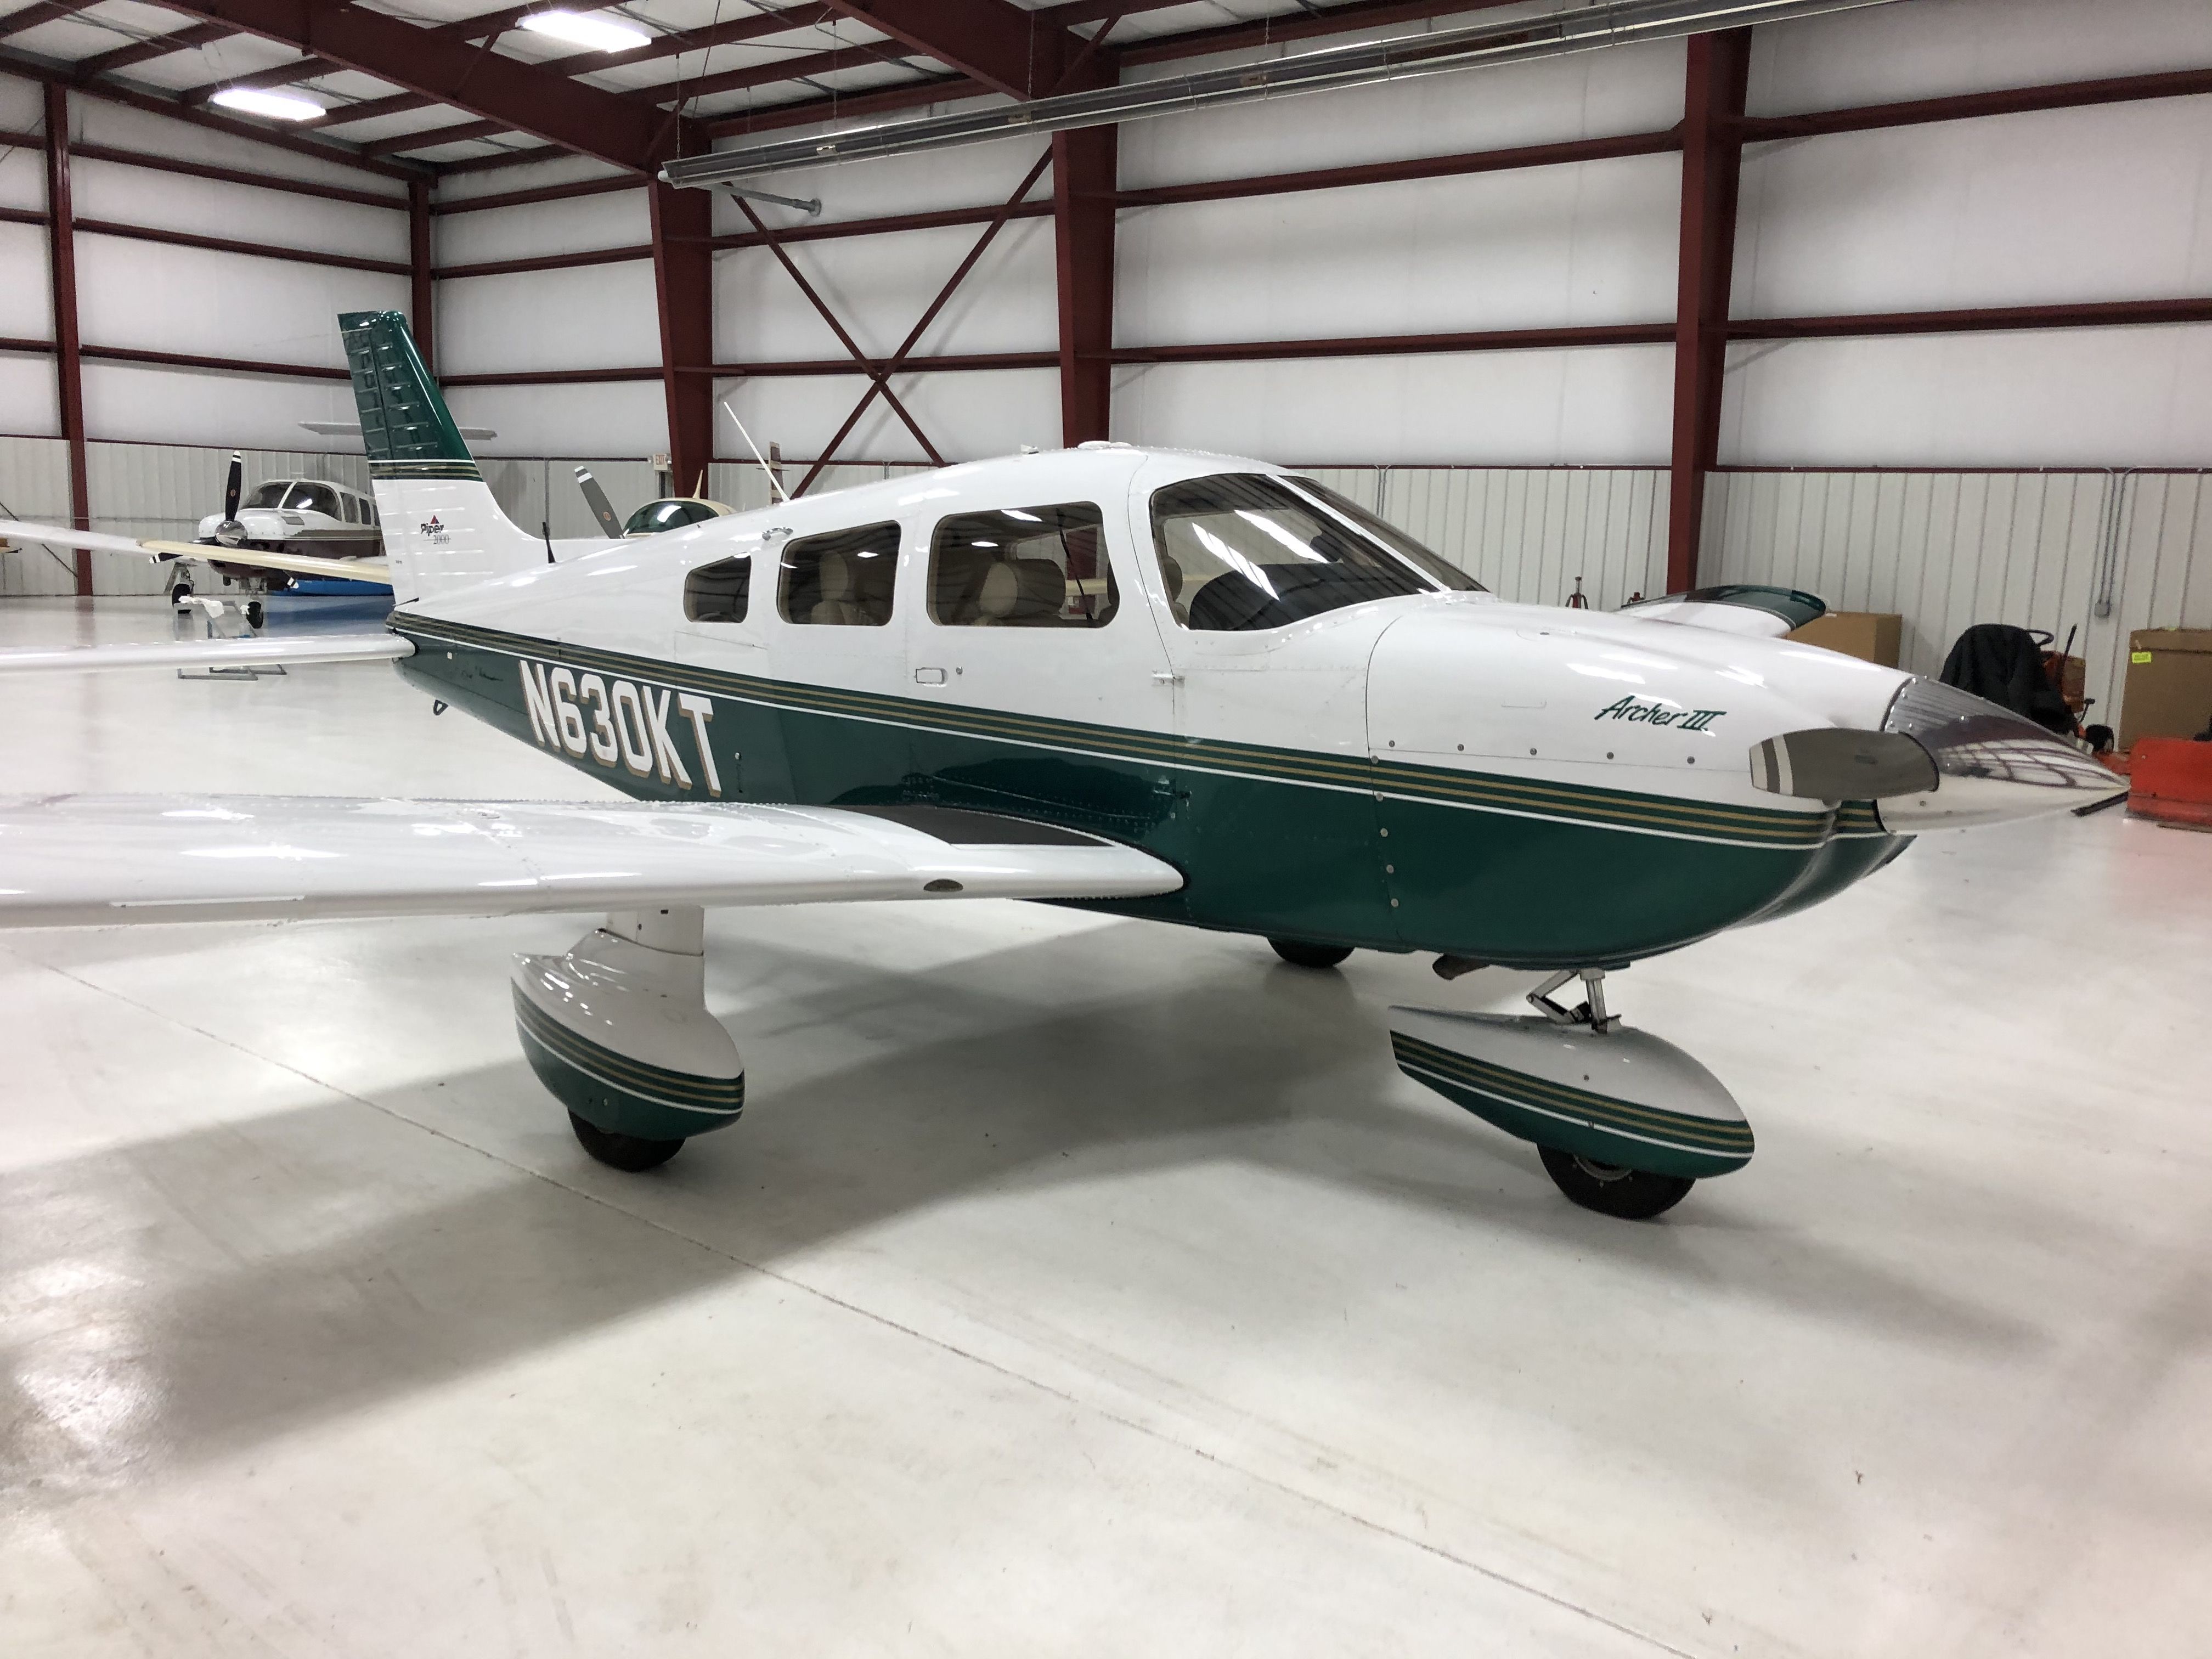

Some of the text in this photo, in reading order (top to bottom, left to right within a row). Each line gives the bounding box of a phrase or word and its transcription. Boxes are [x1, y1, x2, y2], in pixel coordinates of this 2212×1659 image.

[421, 523, 444, 537] Piper
[433, 534, 450, 545] 2000
[1594, 695, 1727, 731] Archer III
[518, 660, 721, 798] N630KT
